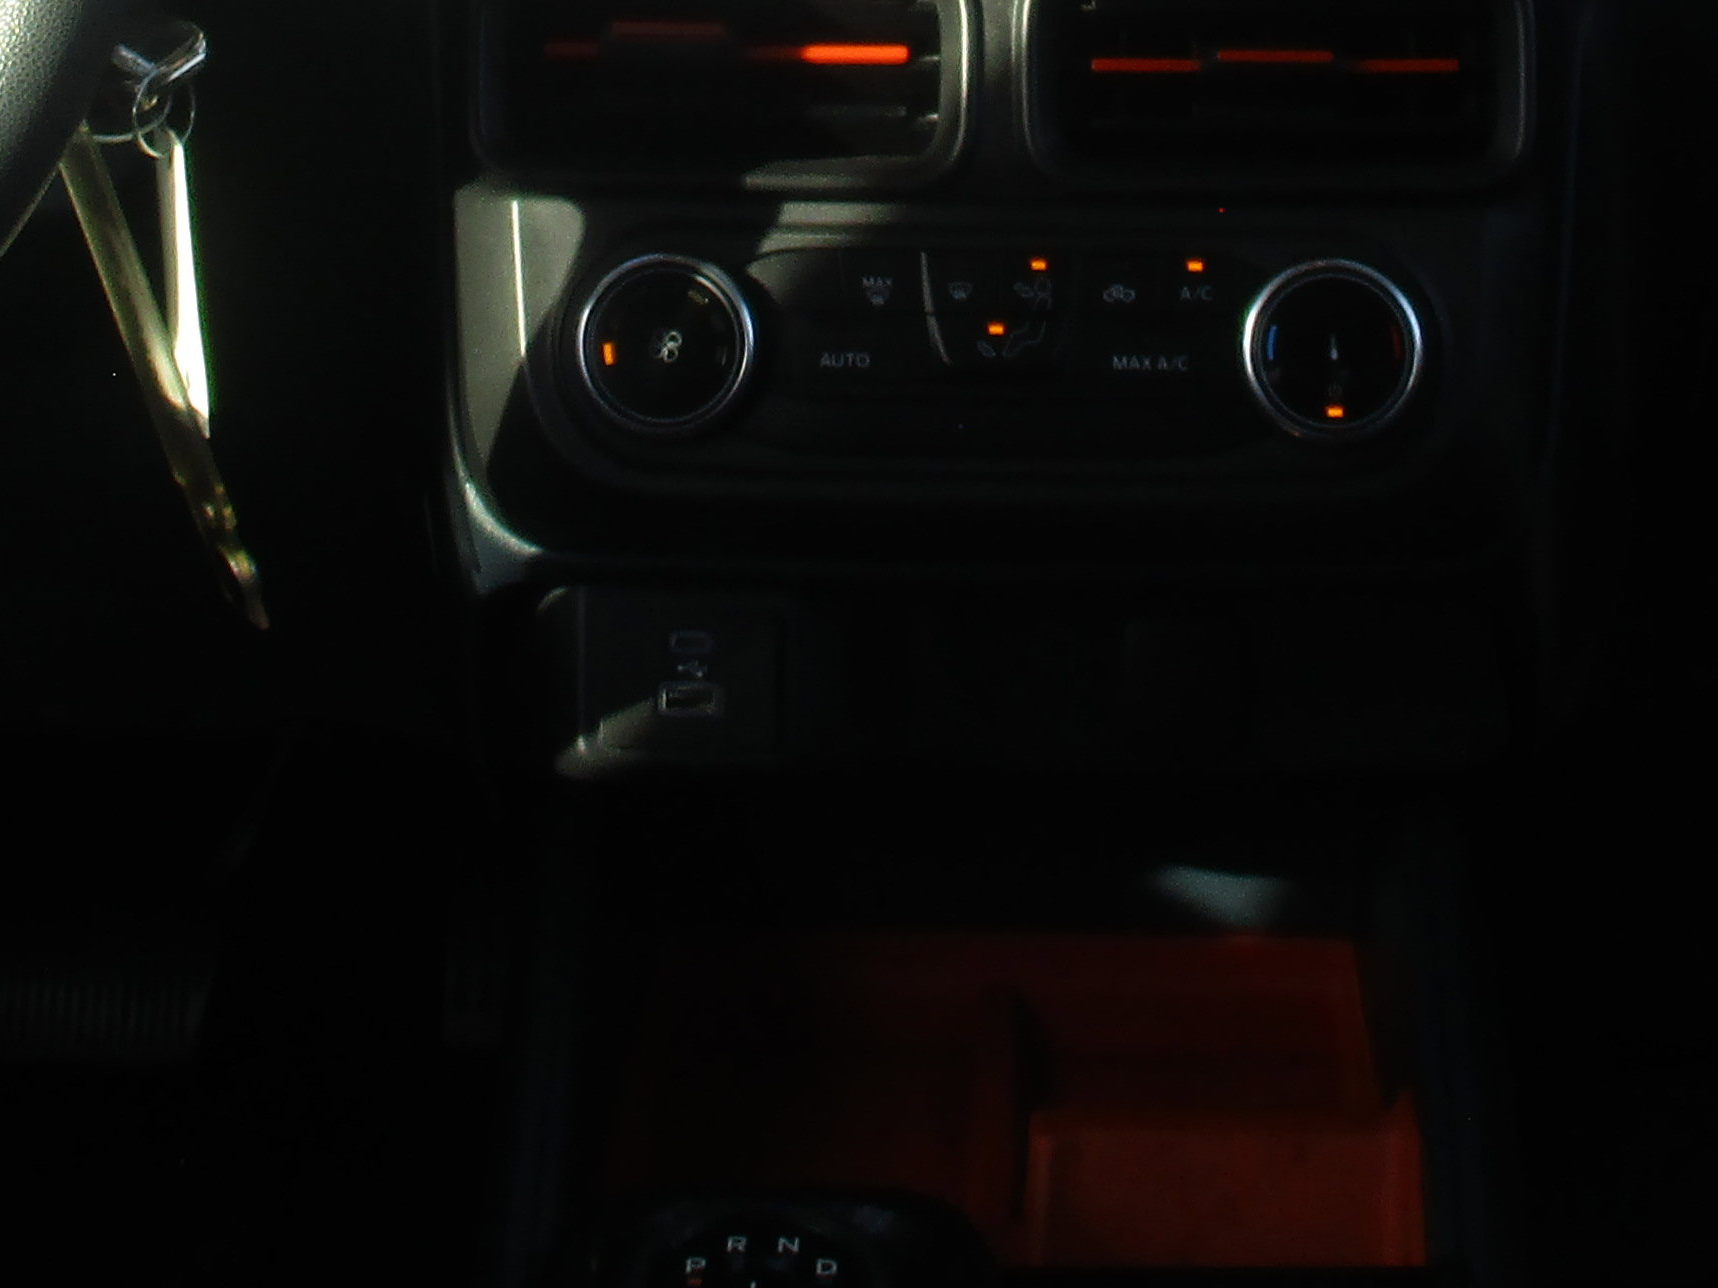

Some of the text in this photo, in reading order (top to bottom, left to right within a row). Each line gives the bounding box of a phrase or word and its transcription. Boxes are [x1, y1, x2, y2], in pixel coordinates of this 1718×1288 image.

[1179, 285, 1213, 302] A/C
[819, 352, 871, 369] AUTO
[1112, 355, 1151, 371] MAX
[685, 1236, 838, 1277] P R N D
